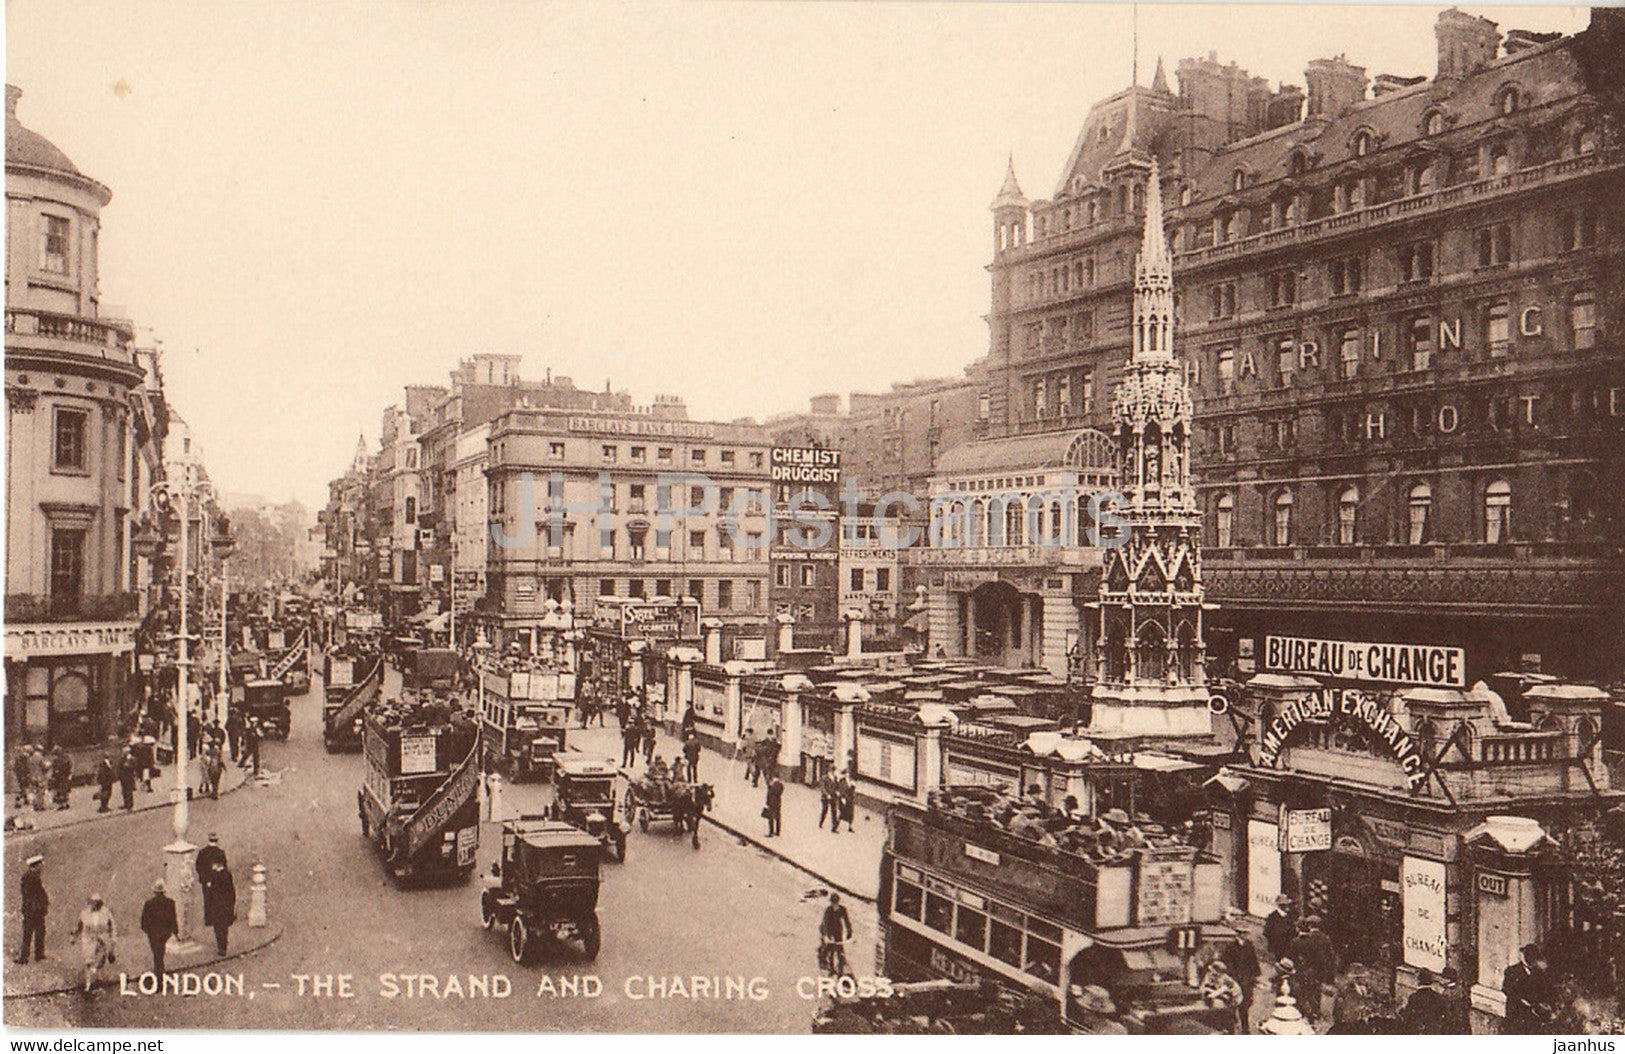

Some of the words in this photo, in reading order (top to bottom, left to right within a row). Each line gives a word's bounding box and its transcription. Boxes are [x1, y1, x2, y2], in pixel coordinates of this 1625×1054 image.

[772, 448, 841, 465] CHEMIST
[772, 466, 841, 483] DRUGGIST
[21, 635, 89, 650] BARCLAYS
[1267, 638, 1345, 675] BUREAU
[1349, 649, 1363, 671] DE
[1366, 646, 1460, 684] CHANGE
[1259, 688, 1334, 768] AMERICAN
[1341, 689, 1426, 790] EXCHANGE
[1289, 810, 1331, 825] BUREAU
[1289, 833, 1330, 848] CHANGE
[1404, 873, 1442, 894] BUREAU
[1480, 875, 1504, 892] OUT
[1417, 907, 1430, 920] DE
[1405, 935, 1443, 958] CHANGE
